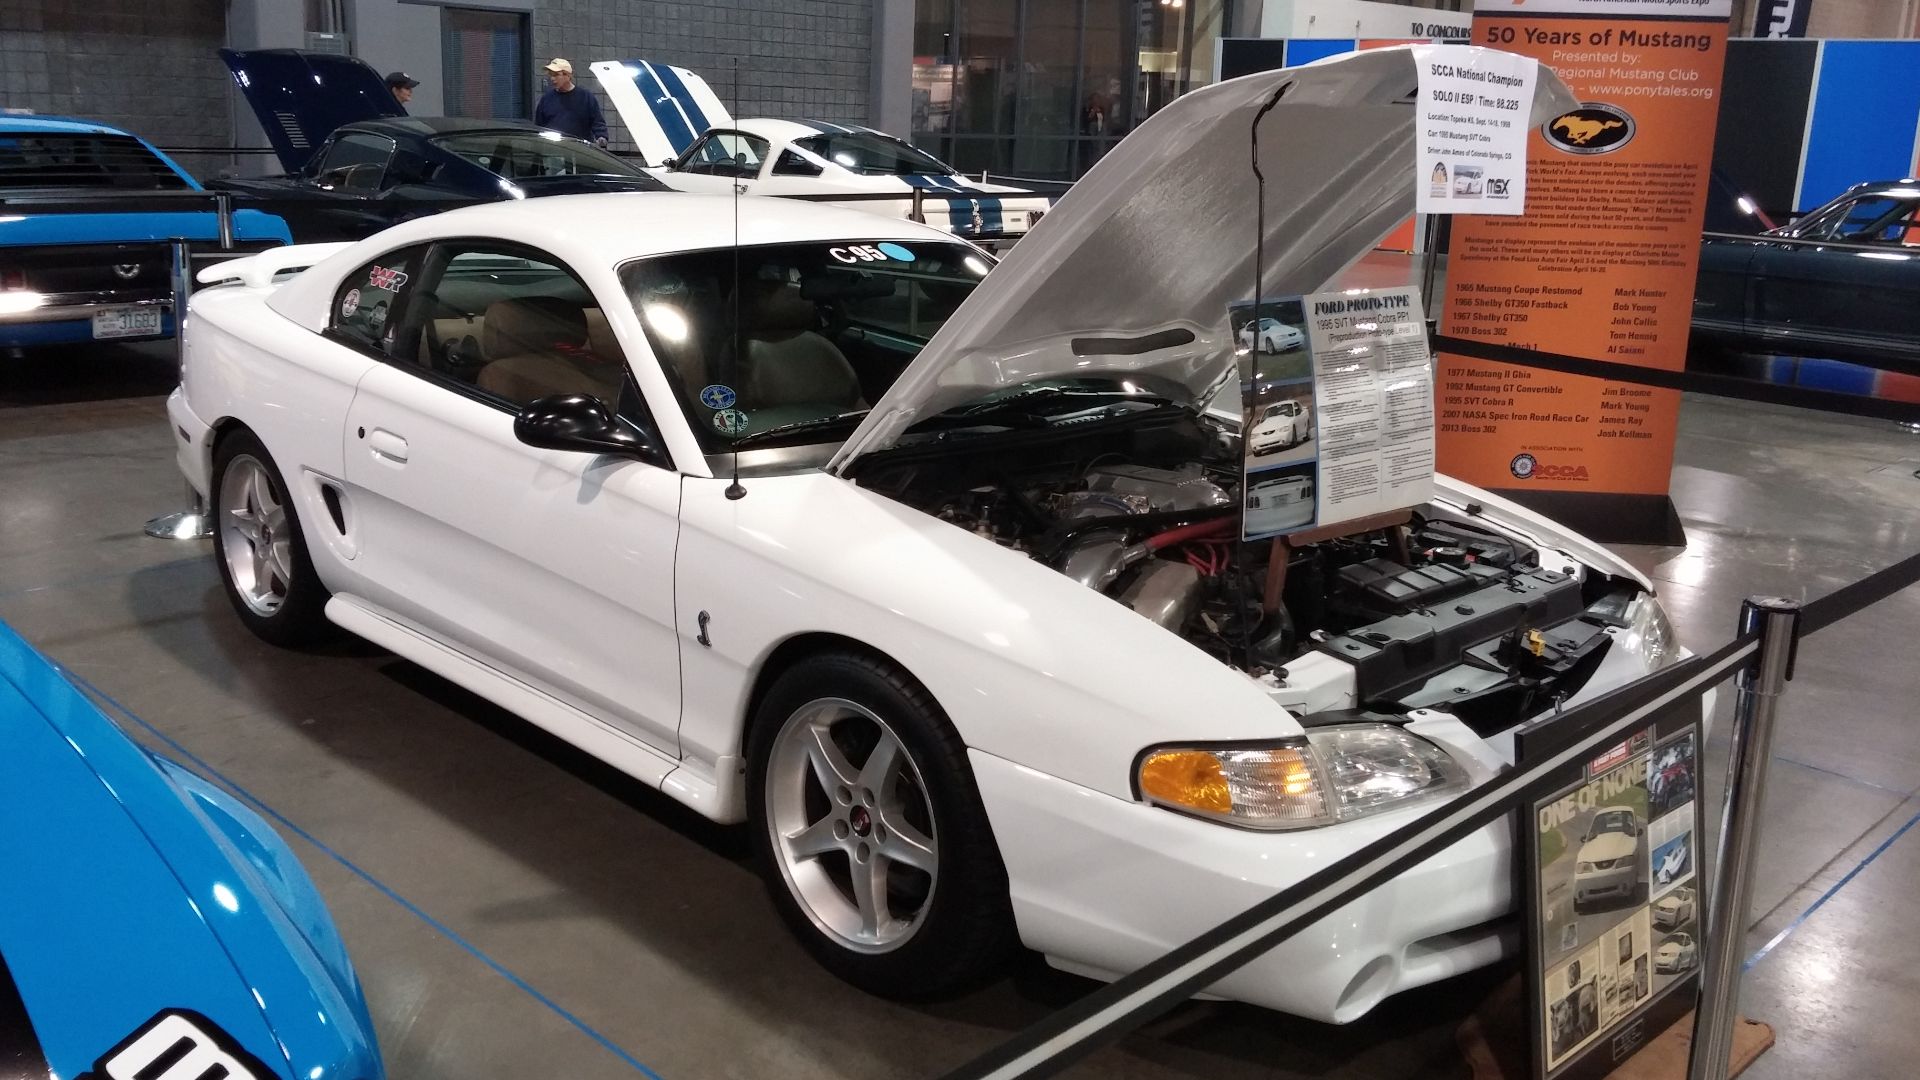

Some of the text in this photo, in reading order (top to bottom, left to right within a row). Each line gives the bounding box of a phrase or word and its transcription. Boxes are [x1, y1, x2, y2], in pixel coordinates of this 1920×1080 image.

[1411, 22, 1424, 36] TO
[1487, 26, 1712, 52] 50 Years of Mustang
[1552, 50, 1641, 65] Presented by:
[1431, 64, 1524, 88] SCCA National Champion
[1609, 68, 1664, 82] Mustang
[1668, 70, 1699, 81] Club
[1589, 84, 1712, 98] www.ponytales.org
[1432, 90, 1454, 102] SOLO
[1461, 93, 1474, 104] ESP
[1478, 96, 1496, 108] Time:
[1450, 114, 1466, 124] Topeka
[1476, 284, 1512, 296] Mustang
[1514, 286, 1540, 296] Coupe
[1542, 286, 1582, 296] Restomod
[1614, 288, 1636, 297] Mark
[1314, 294, 1410, 316] FORD PROTO-TYPE
[1474, 298, 1502, 309] Shelby
[1504, 299, 1530, 308] GT350
[1531, 300, 1568, 310] Fastback
[1612, 302, 1630, 311] Bob
[1631, 304, 1657, 314] Young
[1334, 317, 1348, 328] SVT
[1377, 314, 1396, 324] Cobra
[1472, 313, 1500, 324] Shelby
[1503, 314, 1528, 322] GT350
[1611, 317, 1632, 326] John
[1472, 327, 1491, 336] Boss
[1493, 328, 1508, 336] 302
[1610, 330, 1626, 340] Tom
[1448, 368, 1465, 377] 1977
[1466, 369, 1502, 380] Mustang
[1465, 383, 1500, 393] Mustang
[1502, 384, 1514, 394] GT
[1516, 384, 1563, 394] Convertible
[1602, 388, 1618, 396] Jim
[1620, 388, 1652, 397] Broome
[1464, 397, 1481, 406] SVT
[1482, 398, 1506, 406] Cobra
[1508, 398, 1514, 406] R
[1601, 402, 1622, 410] Mark
[1624, 402, 1650, 412] Young
[1462, 410, 1487, 420] NASA
[1489, 412, 1510, 422] Spec
[1511, 412, 1528, 420] Iron
[1530, 412, 1550, 422] Road
[1552, 414, 1573, 422] Race
[1574, 415, 1590, 423] Car
[1599, 416, 1626, 424] James
[1441, 424, 1459, 432] 2013
[1461, 424, 1480, 433] Boss
[1483, 426, 1496, 434] 302
[1597, 429, 1616, 438] Josh
[1534, 464, 1589, 478] SCCA
[1538, 758, 1647, 834] ONE OF NONE
